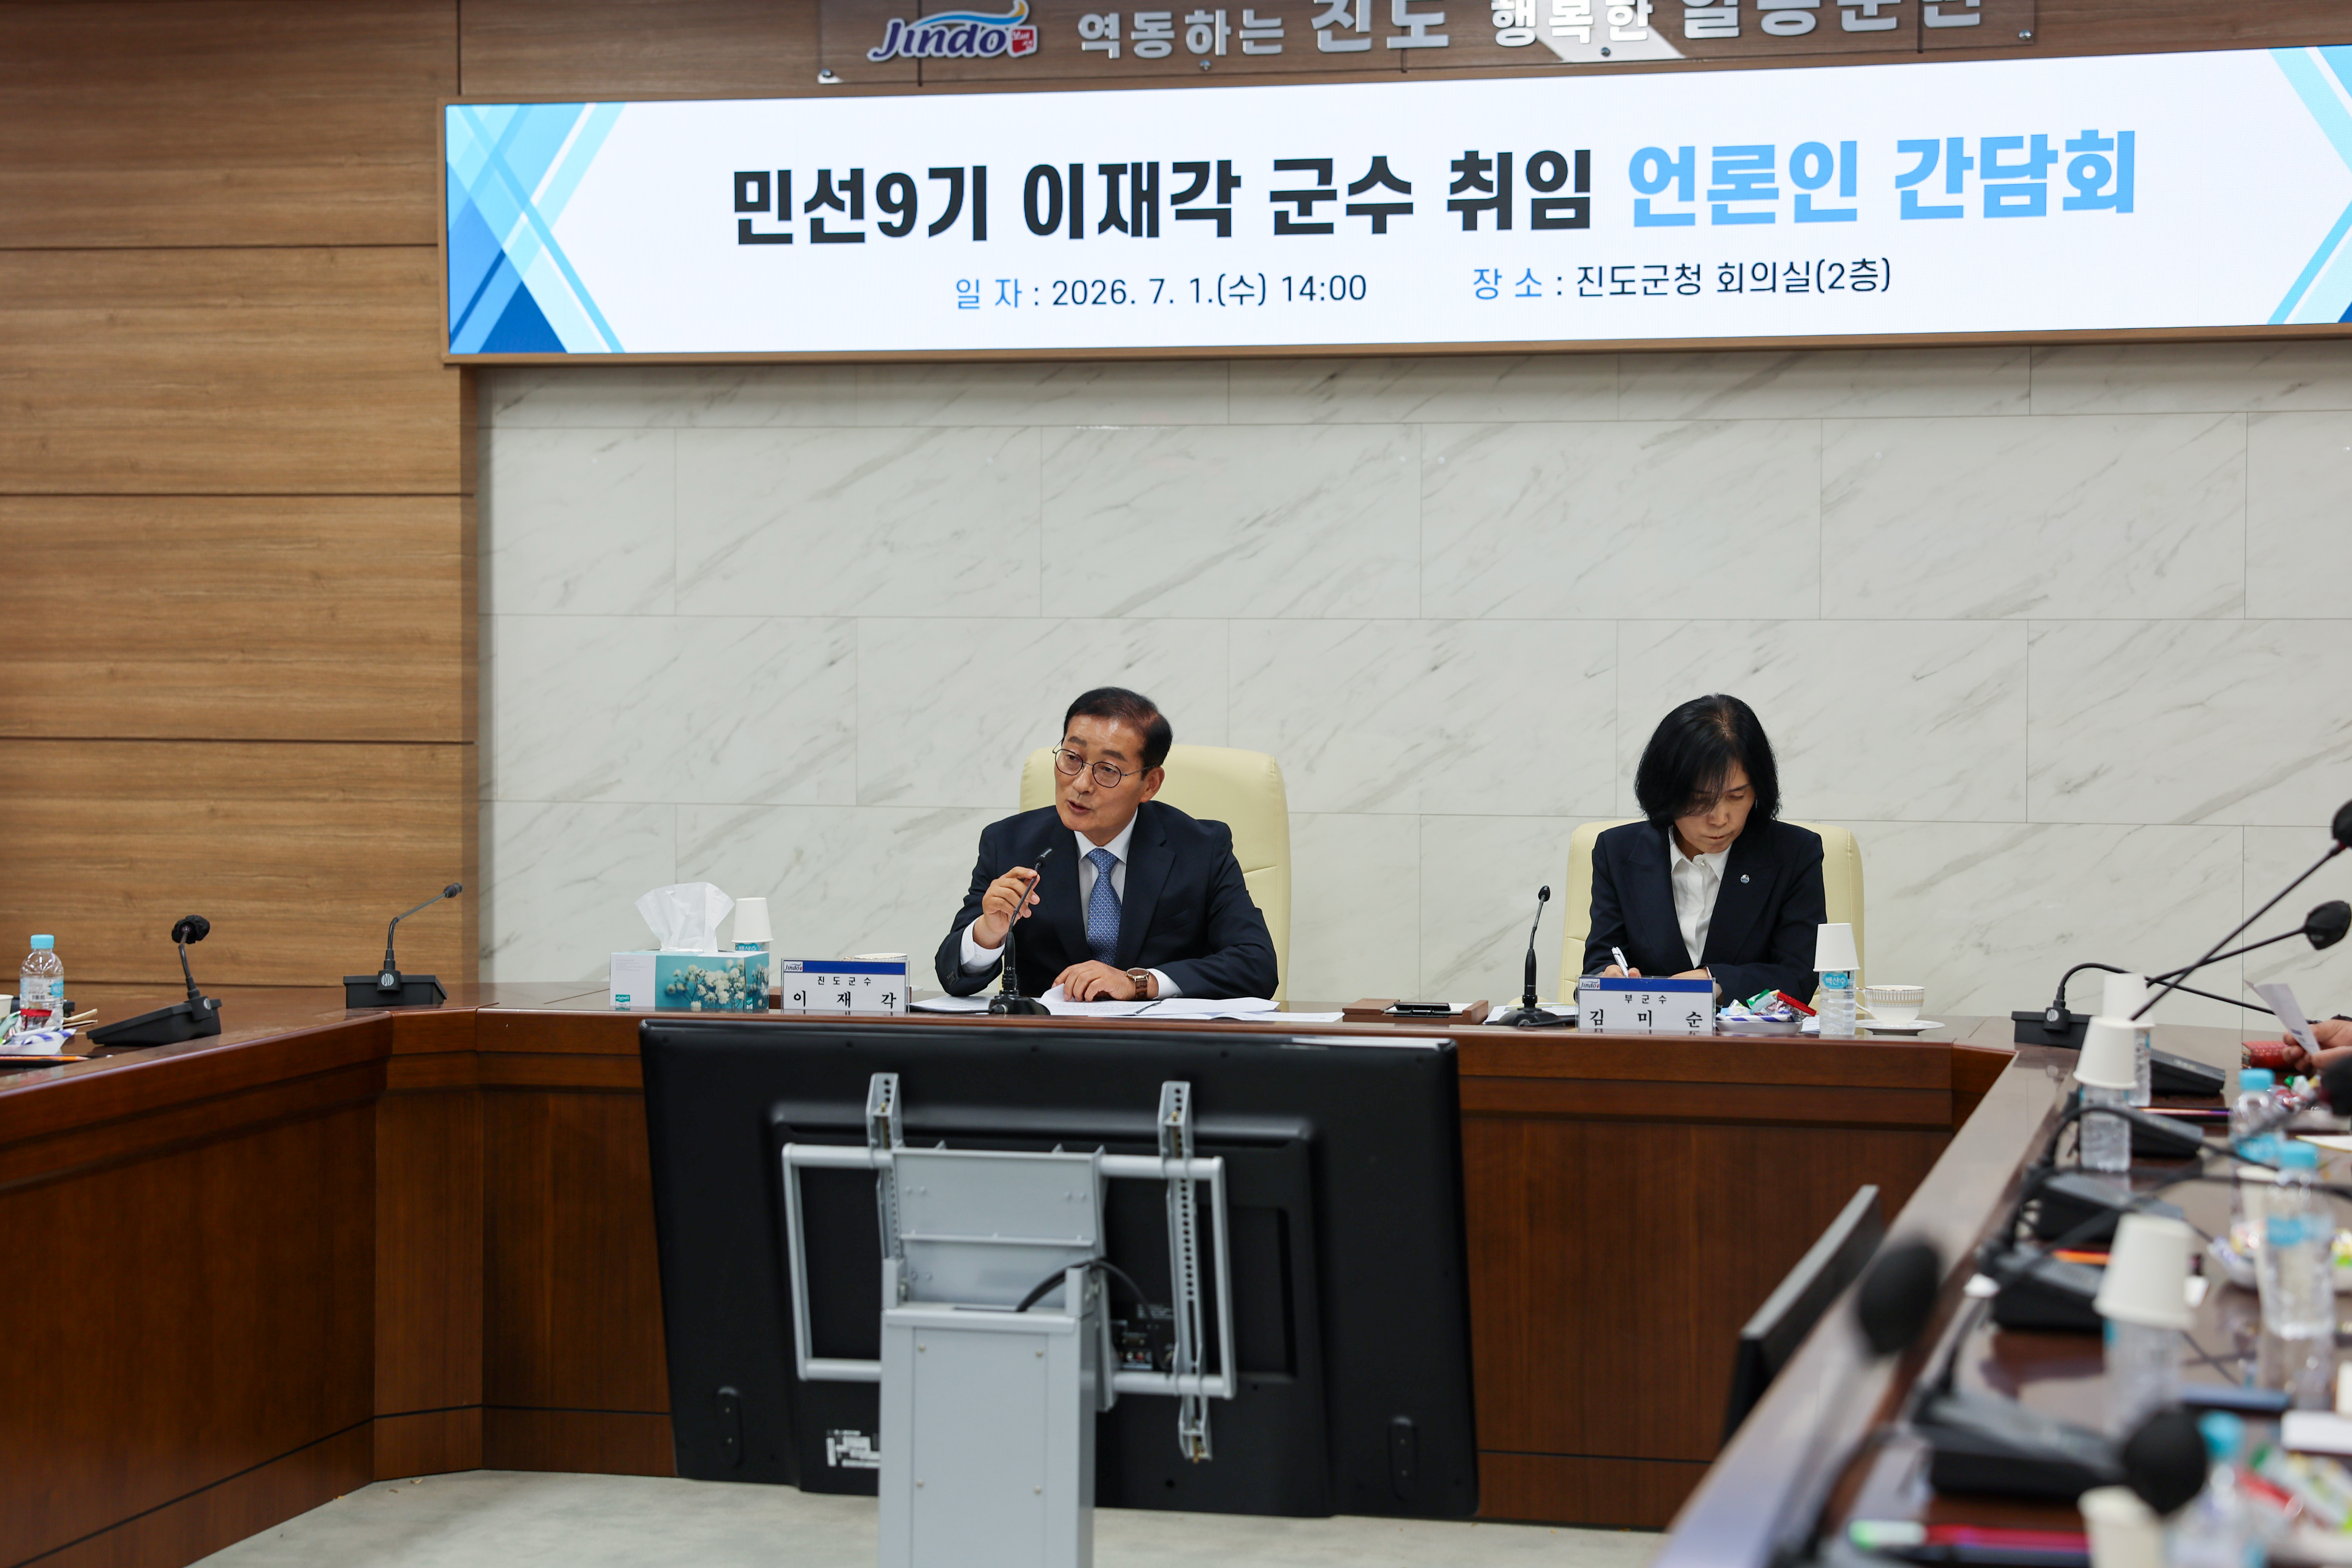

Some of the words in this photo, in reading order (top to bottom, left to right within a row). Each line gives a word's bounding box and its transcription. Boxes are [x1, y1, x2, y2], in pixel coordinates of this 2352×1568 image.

[870, 21, 1007, 59] Jindo
[1078, 9, 1285, 59] 역동하는
[1310, 0, 1449, 53] 진도
[1491, 0, 1653, 47] 행복한
[734, 165, 987, 245] 민선9기
[1024, 160, 1241, 240] 이재각
[1270, 156, 1413, 236] 군수
[1447, 149, 1591, 231] 취임
[1629, 141, 1857, 227] 언론인
[1895, 129, 2134, 220] 간담회
[1053, 279, 1135, 306] 2026.
[1149, 278, 1173, 304] 7.
[1282, 274, 1366, 302] 14:00
[1577, 263, 1700, 297] 진도군청
[1717, 258, 1890, 294] 회의실(2층)
[1825, 976, 1846, 985] 백산수
